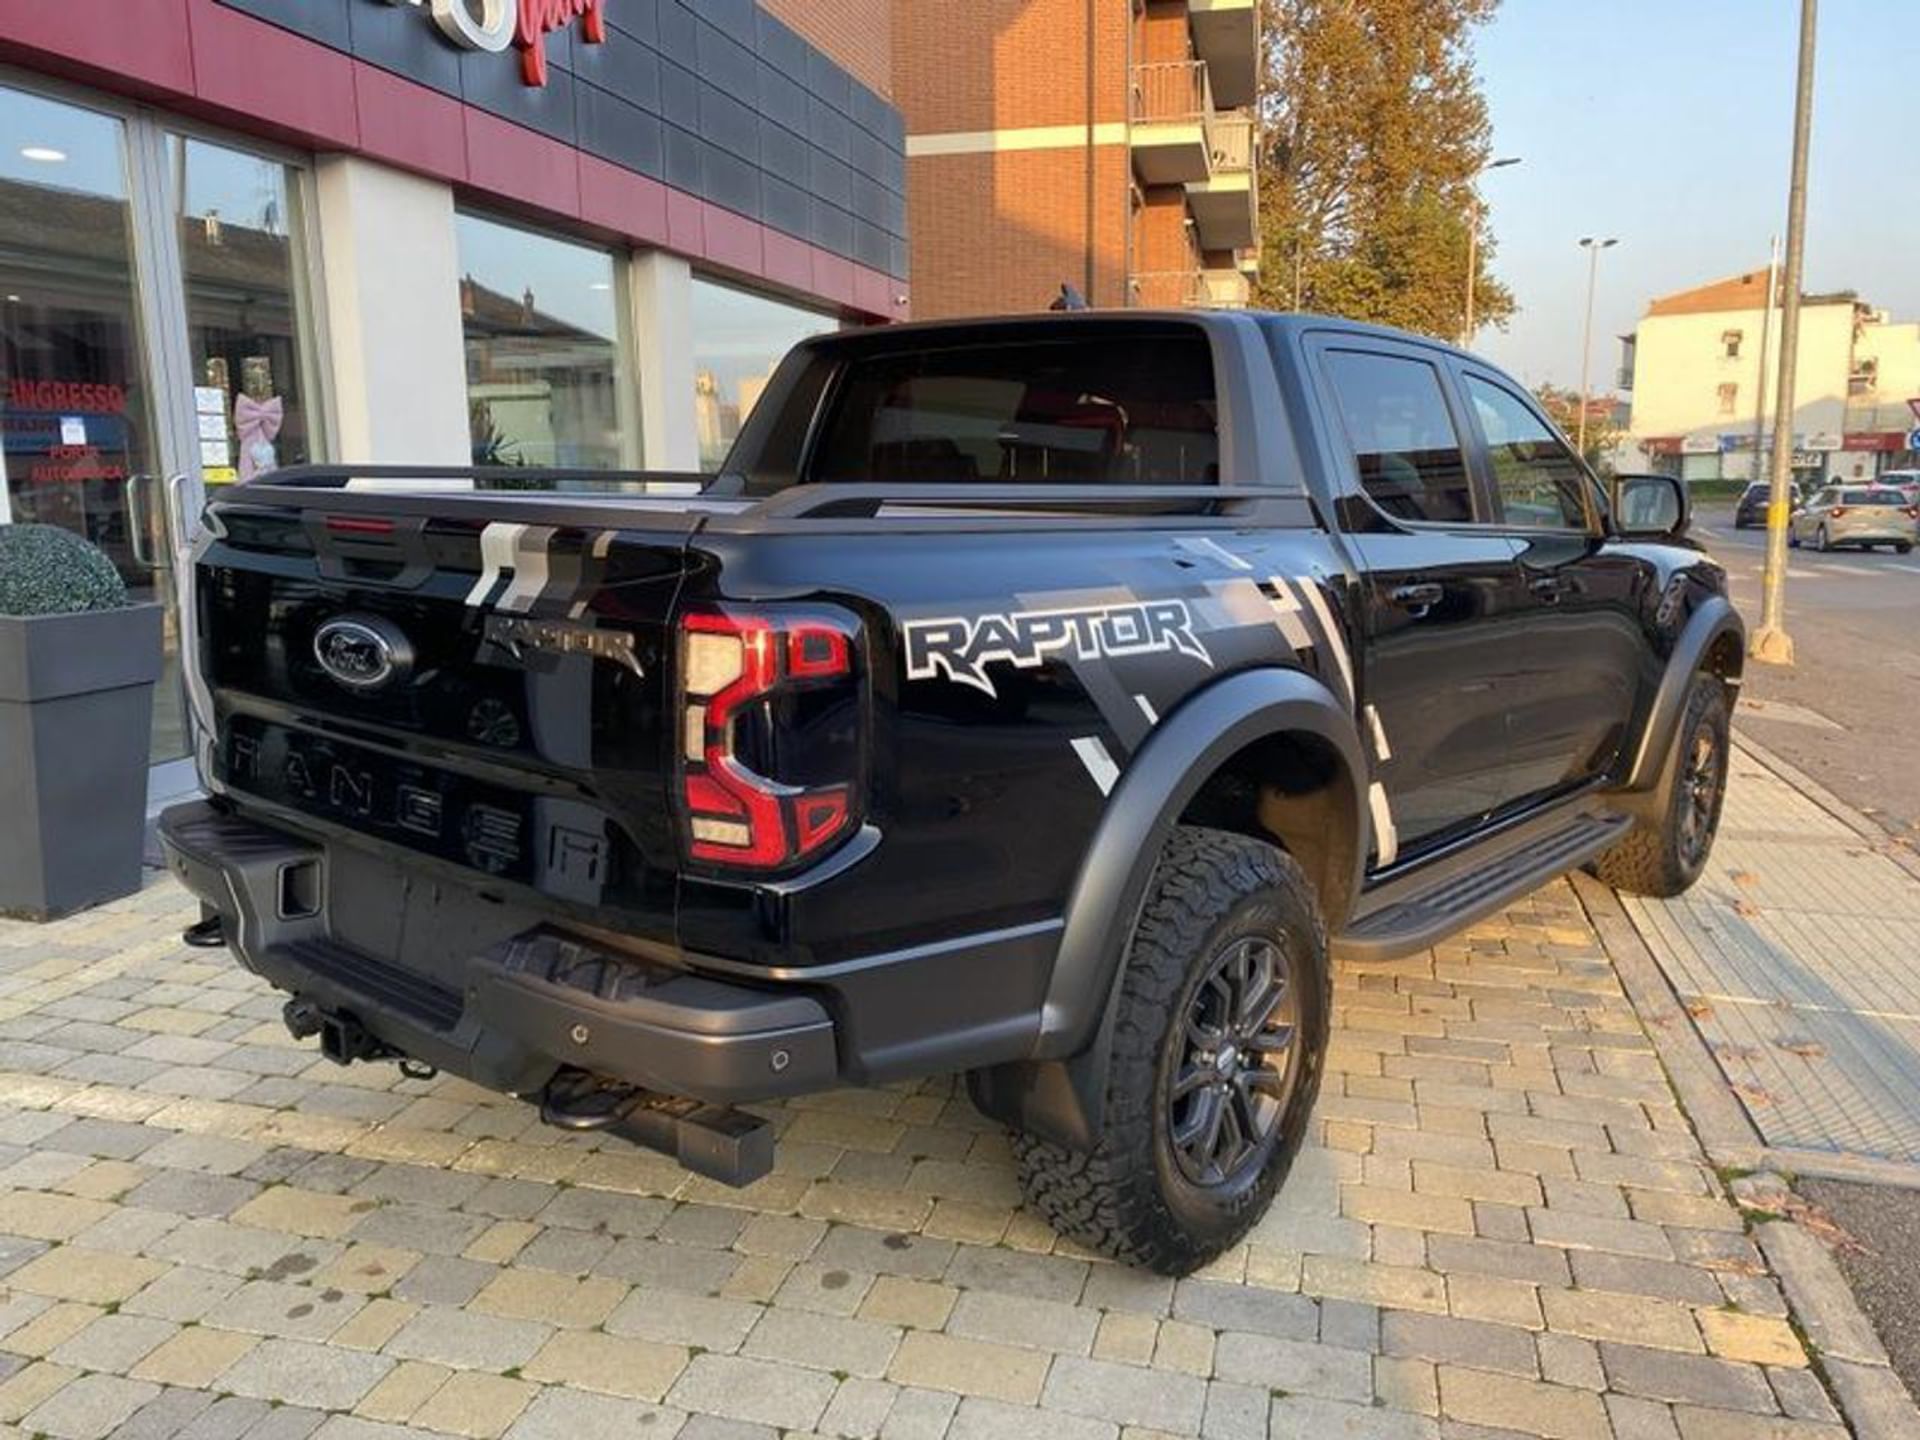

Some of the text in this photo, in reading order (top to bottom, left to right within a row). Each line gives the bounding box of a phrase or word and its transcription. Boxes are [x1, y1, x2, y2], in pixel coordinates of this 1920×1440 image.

[12, 381, 125, 412] INGRESSO
[902, 599, 1214, 698] RAPTOR
[233, 732, 608, 882] RANGER
